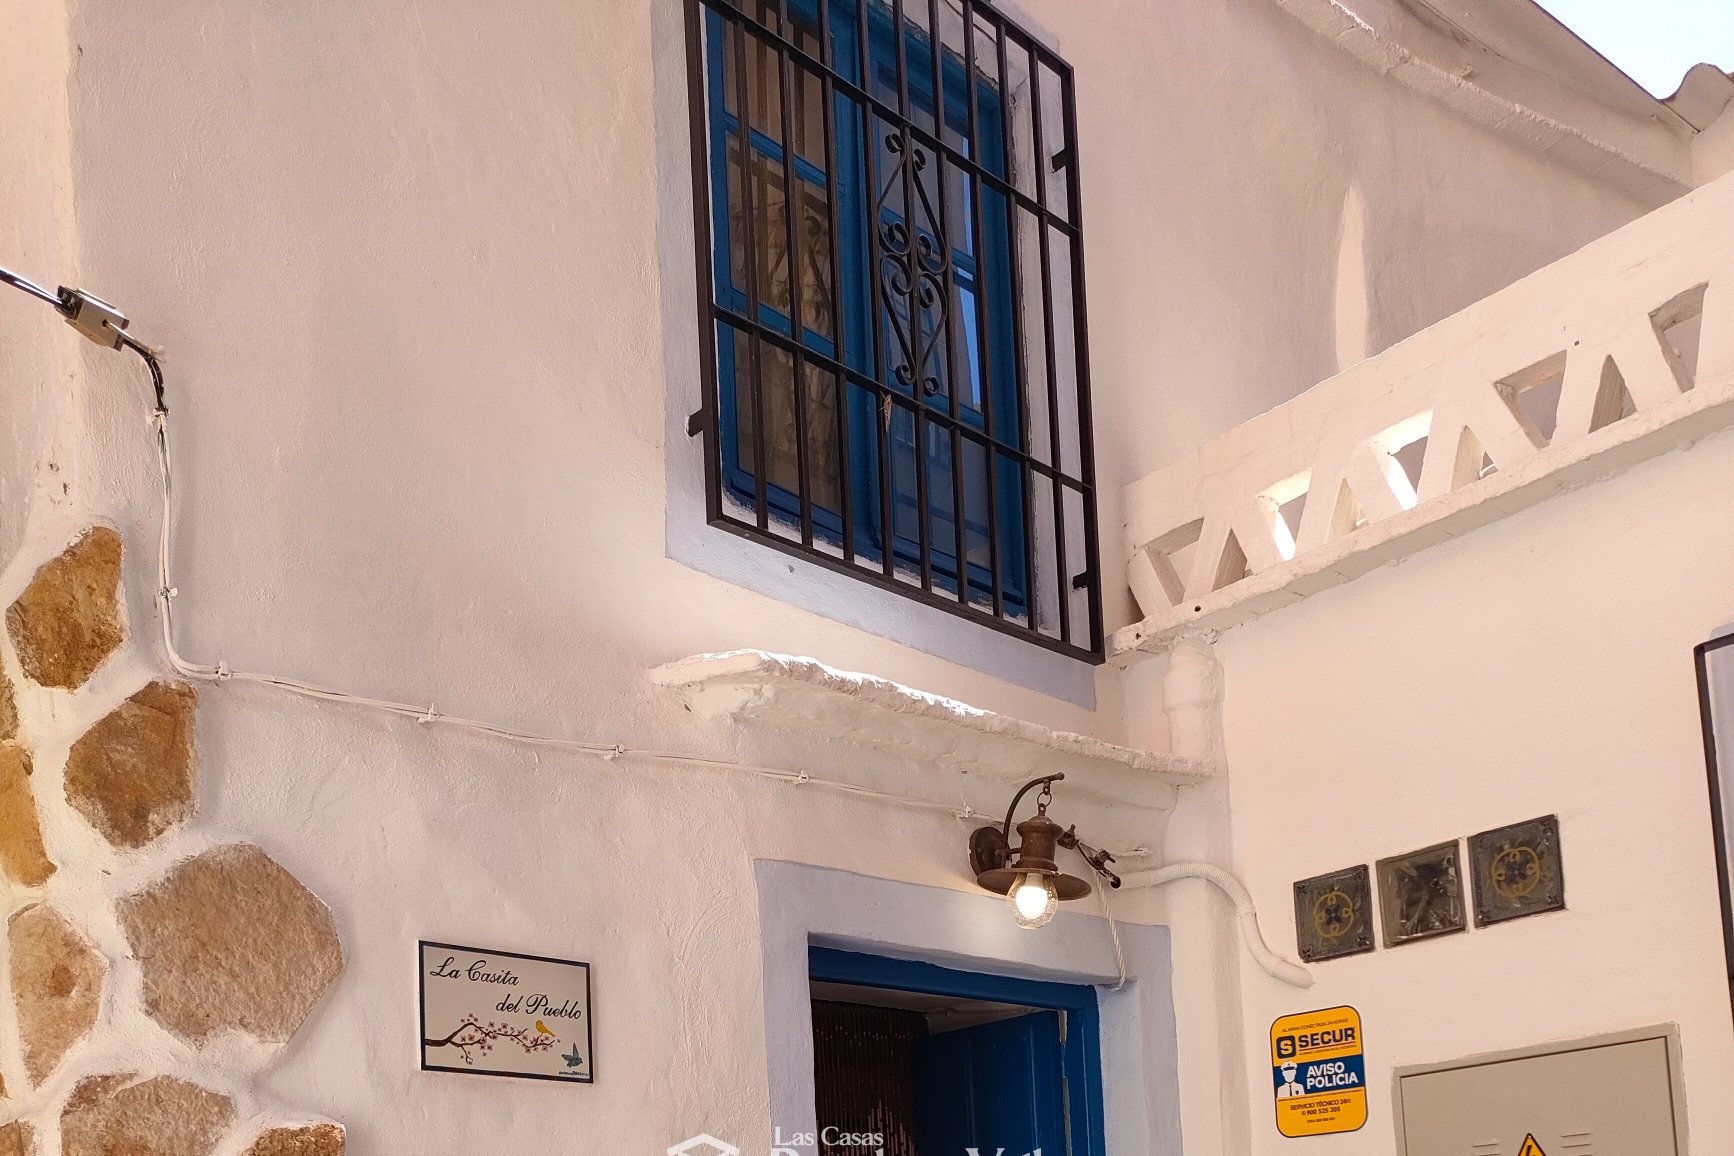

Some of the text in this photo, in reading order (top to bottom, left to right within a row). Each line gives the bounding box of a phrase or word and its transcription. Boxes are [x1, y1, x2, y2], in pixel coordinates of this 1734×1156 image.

[430, 957, 519, 986] La Casita
[496, 994, 582, 1020] del Pueblo
[1298, 1027, 1355, 1048] SECUR
[1306, 1061, 1345, 1078] AVISO
[1306, 1072, 1358, 1090] POLICIA
[1290, 1103, 1315, 1111] SERVICIO
